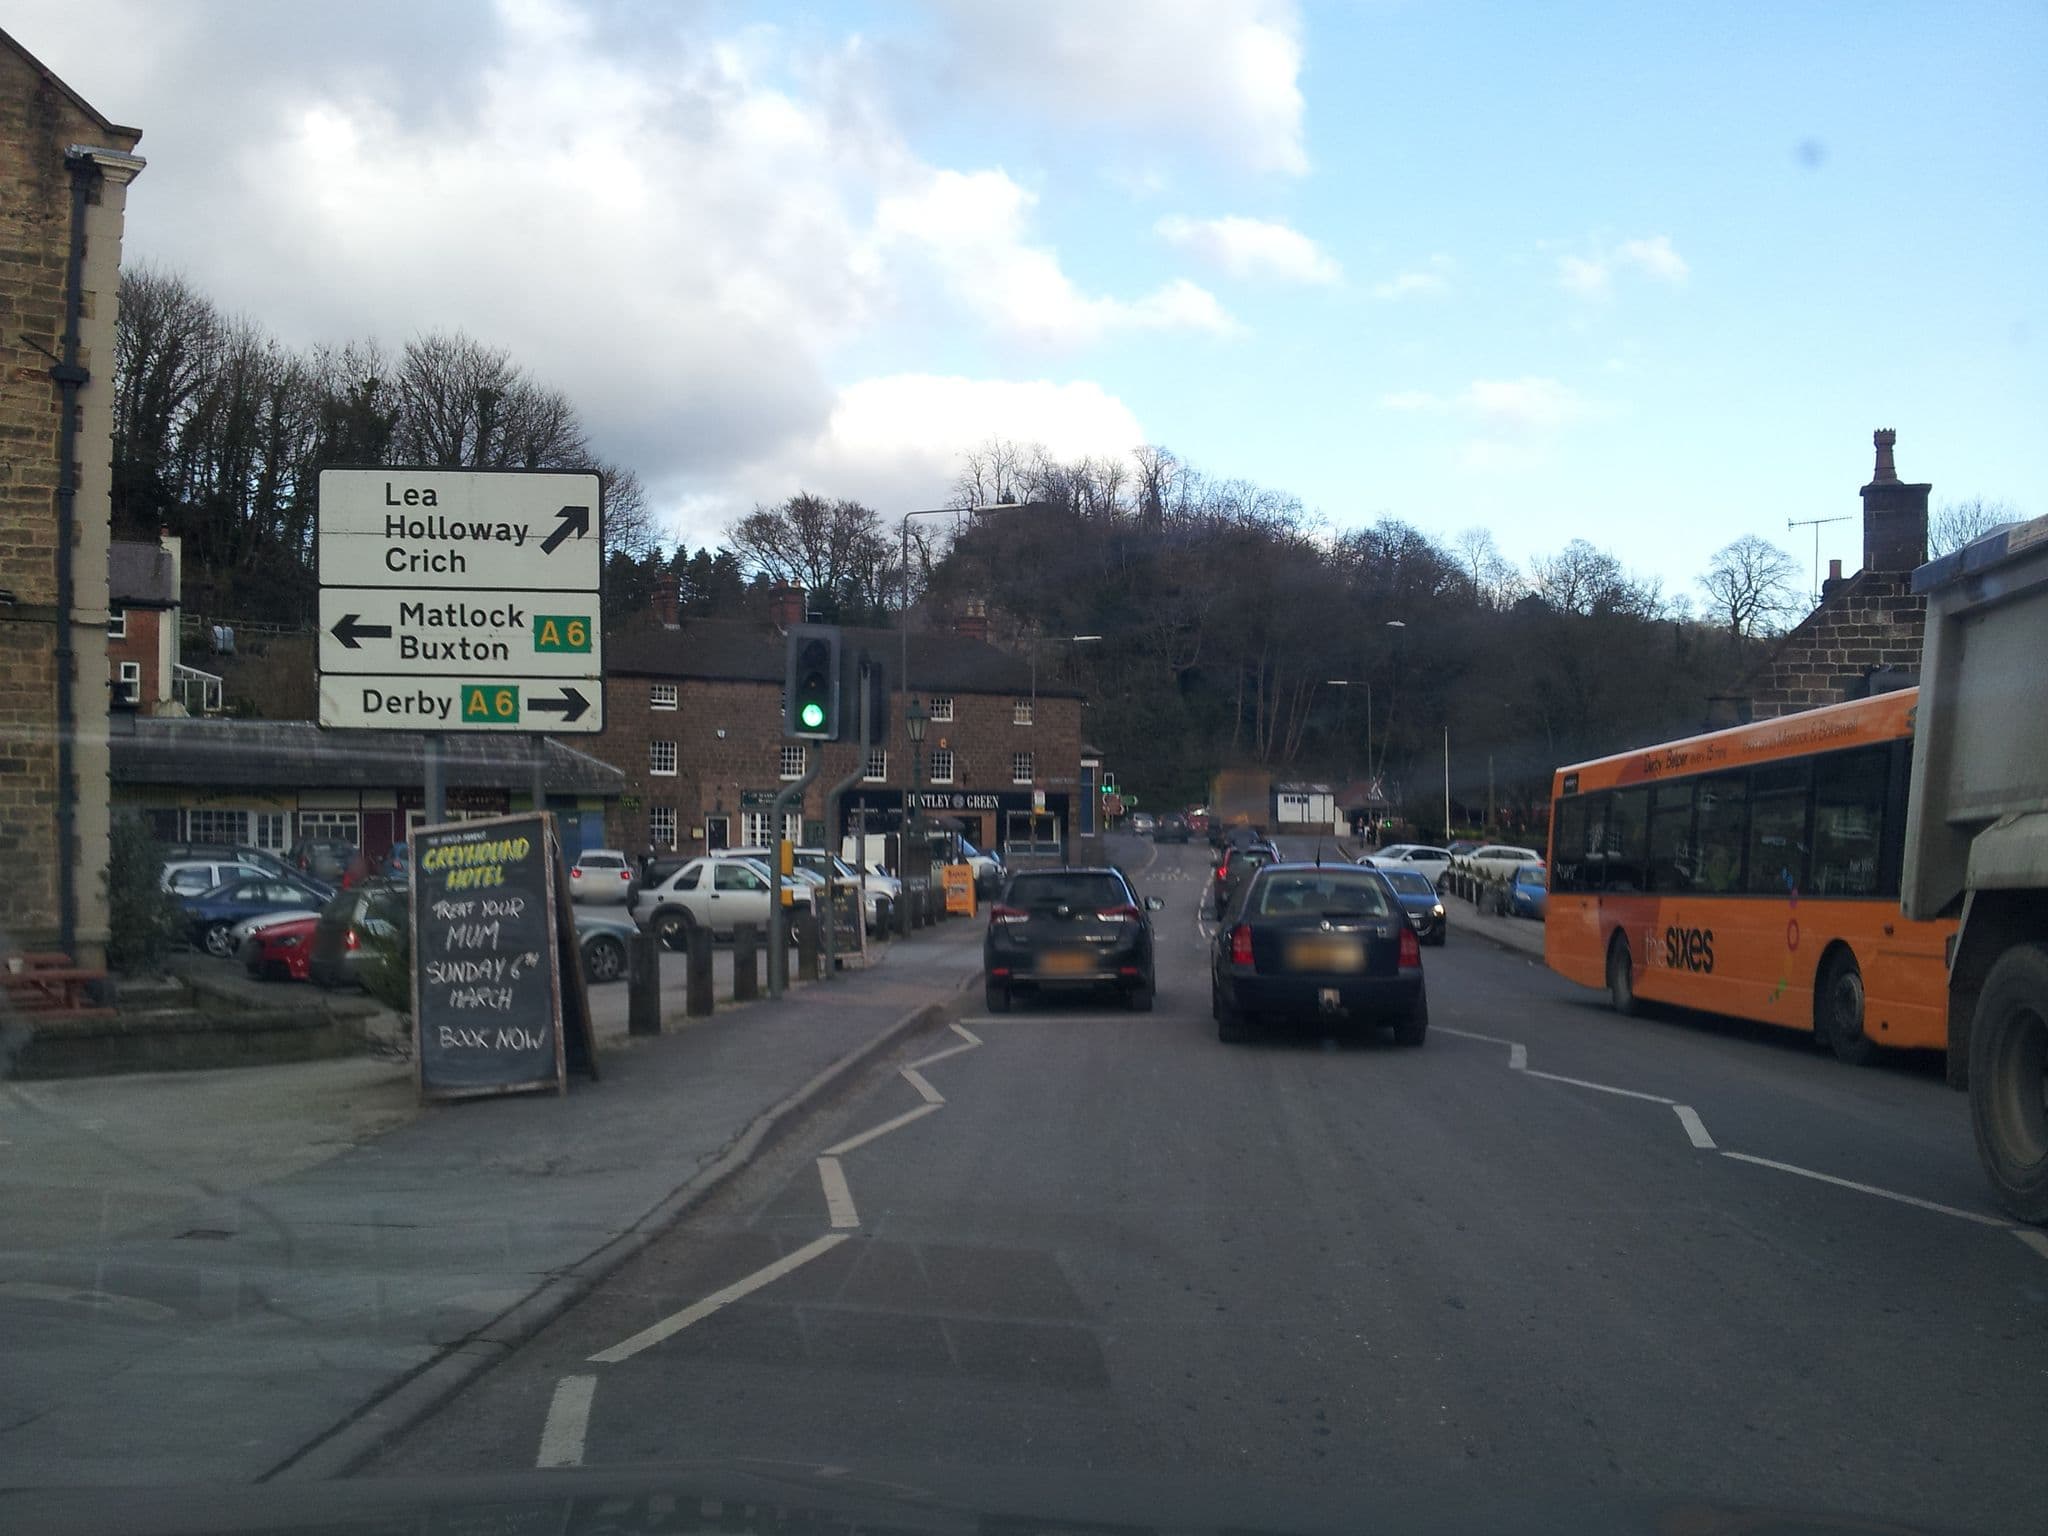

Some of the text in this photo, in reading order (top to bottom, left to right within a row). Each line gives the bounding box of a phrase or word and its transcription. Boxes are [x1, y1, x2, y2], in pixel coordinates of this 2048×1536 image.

[385, 482, 438, 506] Lea
[385, 515, 529, 546] Holloway
[385, 547, 466, 573] Crich
[399, 602, 525, 628] Matlock
[400, 635, 509, 661] Buxton
[362, 689, 452, 720] Derby
[966, 794, 999, 809] GREEN
[422, 837, 530, 873] GREYHOUND
[446, 866, 505, 891] HOTEL
[481, 897, 525, 919] YOUR
[446, 920, 500, 951] MUM
[426, 957, 506, 985] SUNDAY
[449, 986, 513, 1010] MARCH
[438, 1025, 546, 1051] BOOK NOW
